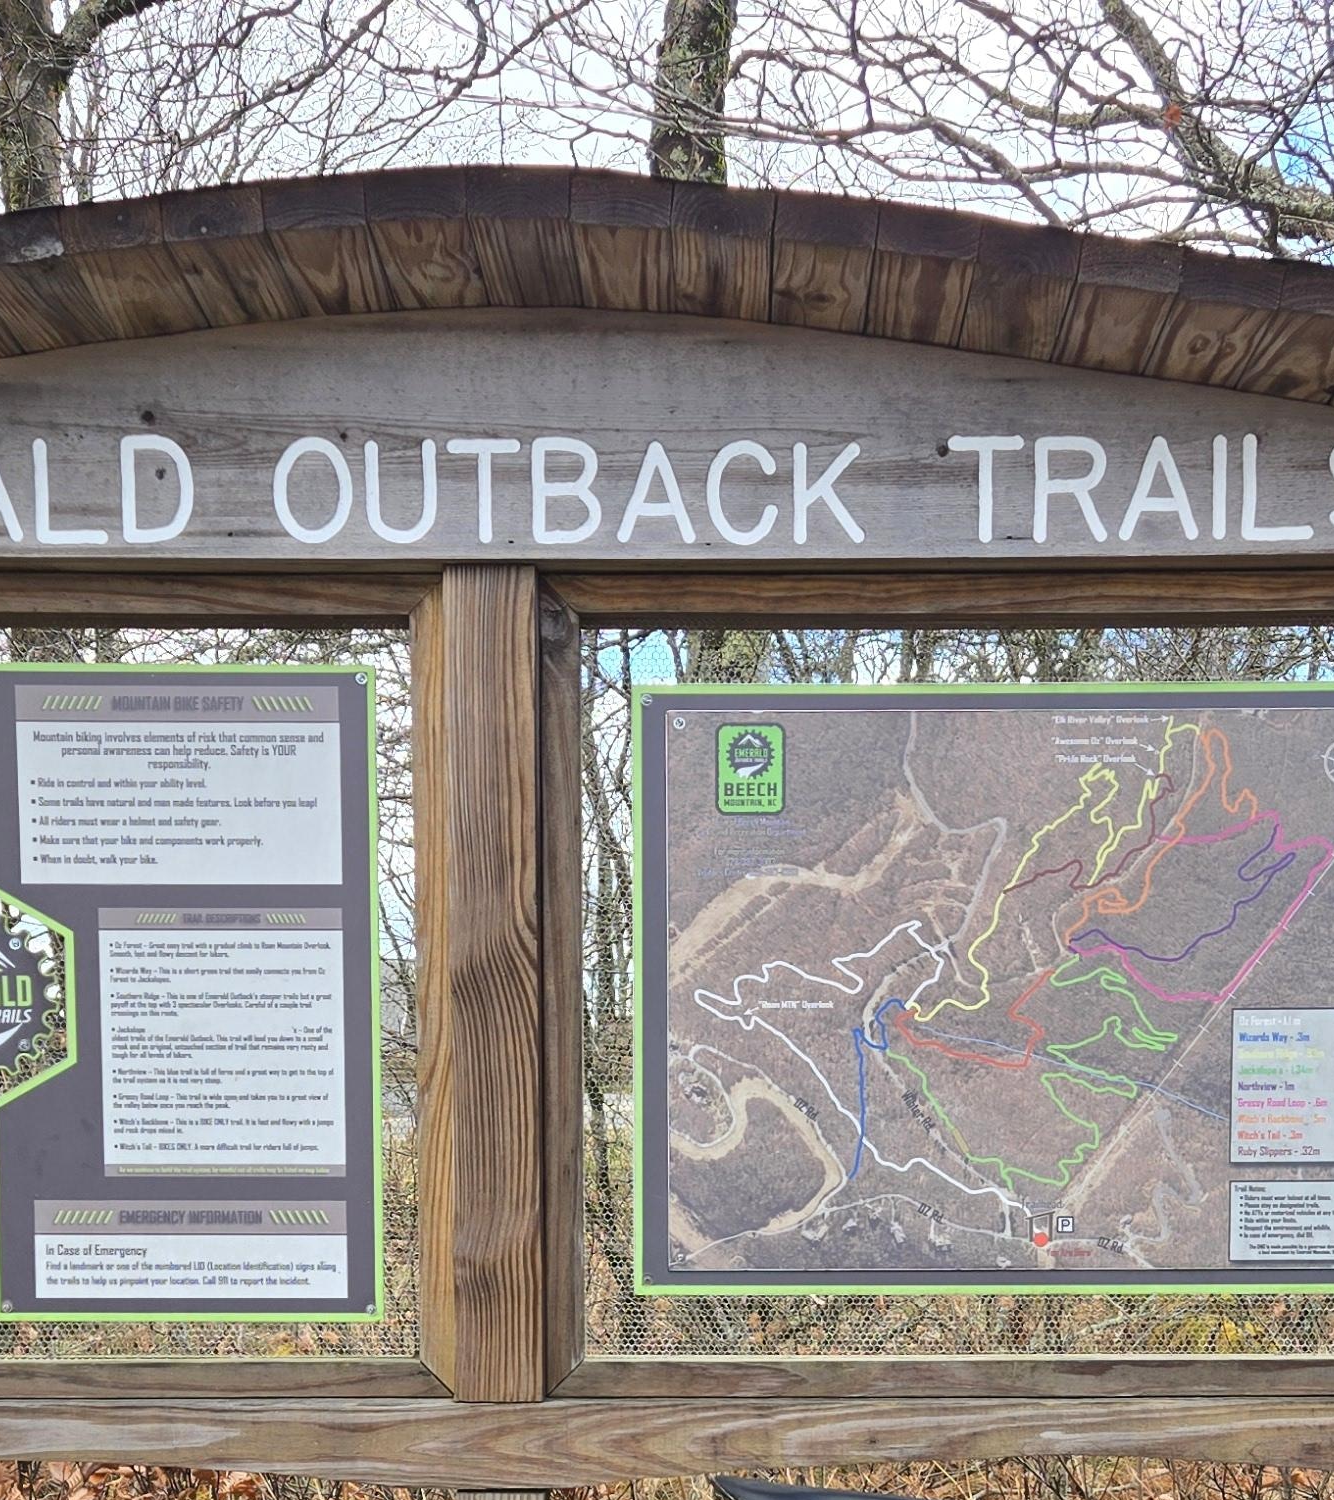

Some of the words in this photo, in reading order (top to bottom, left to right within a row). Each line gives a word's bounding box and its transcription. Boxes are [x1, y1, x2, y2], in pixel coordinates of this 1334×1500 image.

[272, 435, 866, 546] OUTBACK
[110, 695, 171, 712] MOUNTAIN
[172, 695, 199, 712] BIKE
[201, 695, 244, 712] SAFETY
[32, 730, 73, 742] Mountain
[75, 731, 102, 744] biking
[104, 731, 141, 742] involves
[143, 731, 184, 742] elements
[186, 731, 196, 742] of
[197, 731, 216, 742] risk
[218, 731, 237, 742] that
[238, 734, 277, 742] common
[278, 734, 305, 742] sense
[307, 731, 324, 742] and
[60, 744, 101, 757] personal
[102, 747, 152, 755] awareness
[153, 747, 171, 755] can
[172, 744, 192, 758] help
[229, 744, 259, 758] Safety
[261, 745, 269, 755] is
[271, 744, 296, 755] YOUR
[724, 782, 777, 797] BEECH
[118, 1210, 185, 1224] EMERGENCY
[187, 1210, 262, 1225] INFORMATION
[1061, 1219, 1071, 1231] P
[45, 1244, 54, 1255] In
[57, 1243, 80, 1255] Case
[82, 1243, 92, 1255] of
[94, 1244, 147, 1258] Emergency
